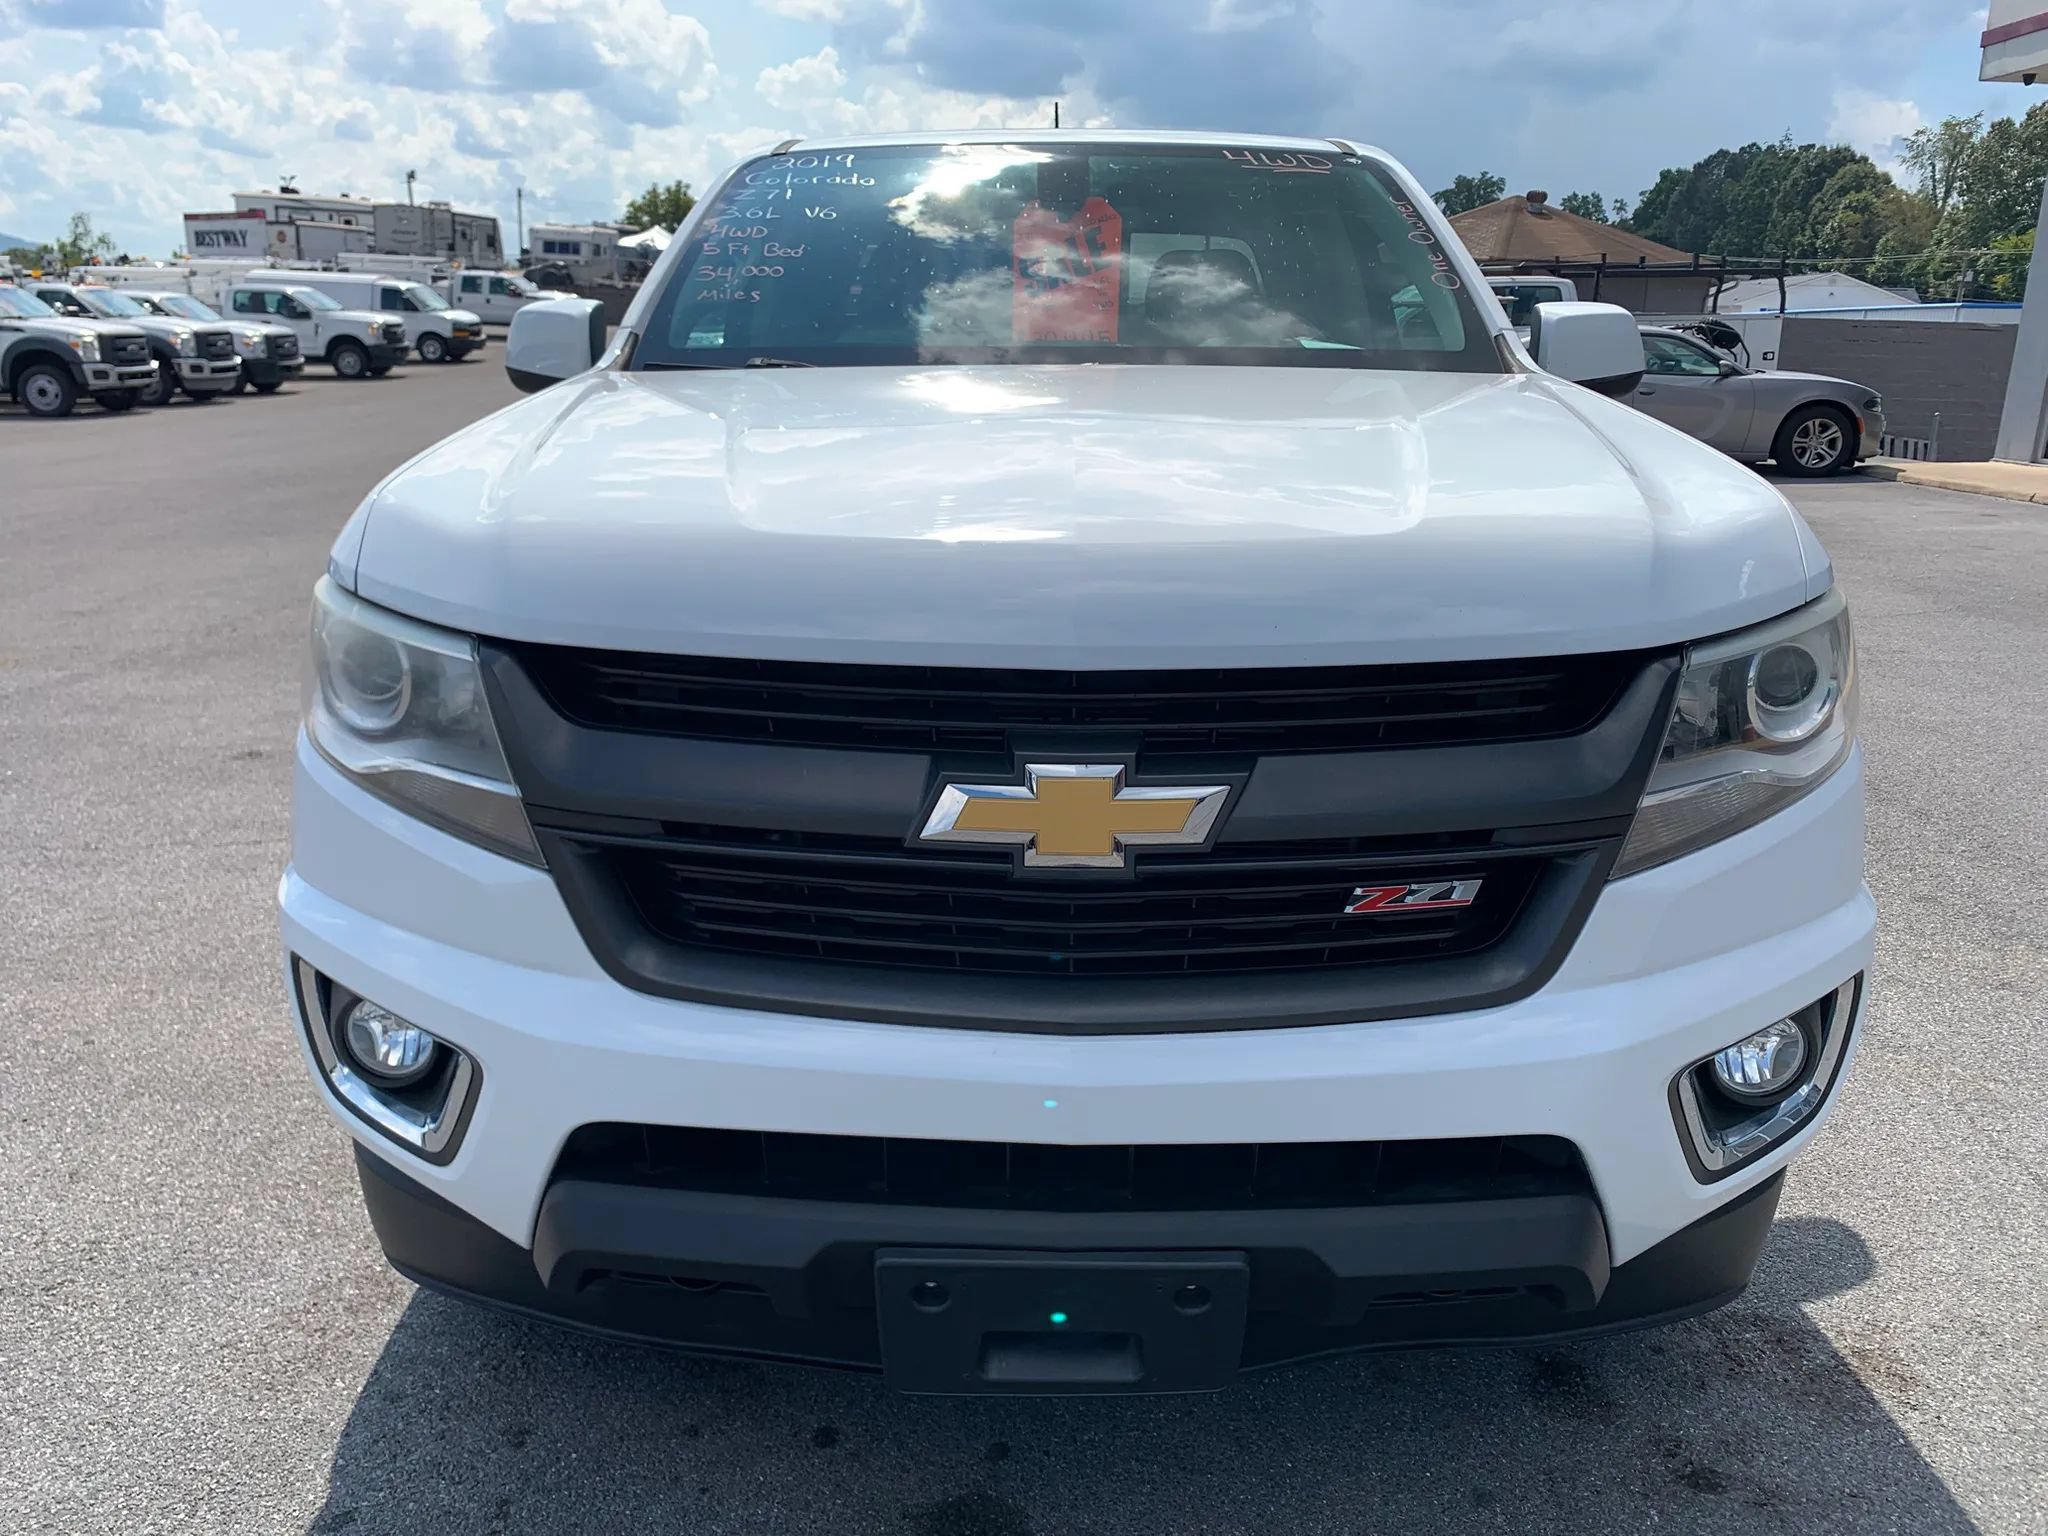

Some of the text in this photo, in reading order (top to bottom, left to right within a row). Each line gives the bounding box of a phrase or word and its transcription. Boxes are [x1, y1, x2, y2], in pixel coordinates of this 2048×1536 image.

[771, 153, 856, 170] 2019
[1222, 150, 1333, 170] 4WD
[745, 171, 876, 187] Colorado
[720, 206, 838, 220] 3.6L V6
[194, 229, 249, 248] BESTWAY
[710, 225, 768, 239] 4WD
[703, 241, 721, 256] 5
[763, 242, 806, 257] Bed
[1389, 196, 1460, 290] One Owner
[697, 287, 761, 303] Miles
[1344, 880, 1483, 914] Z71
